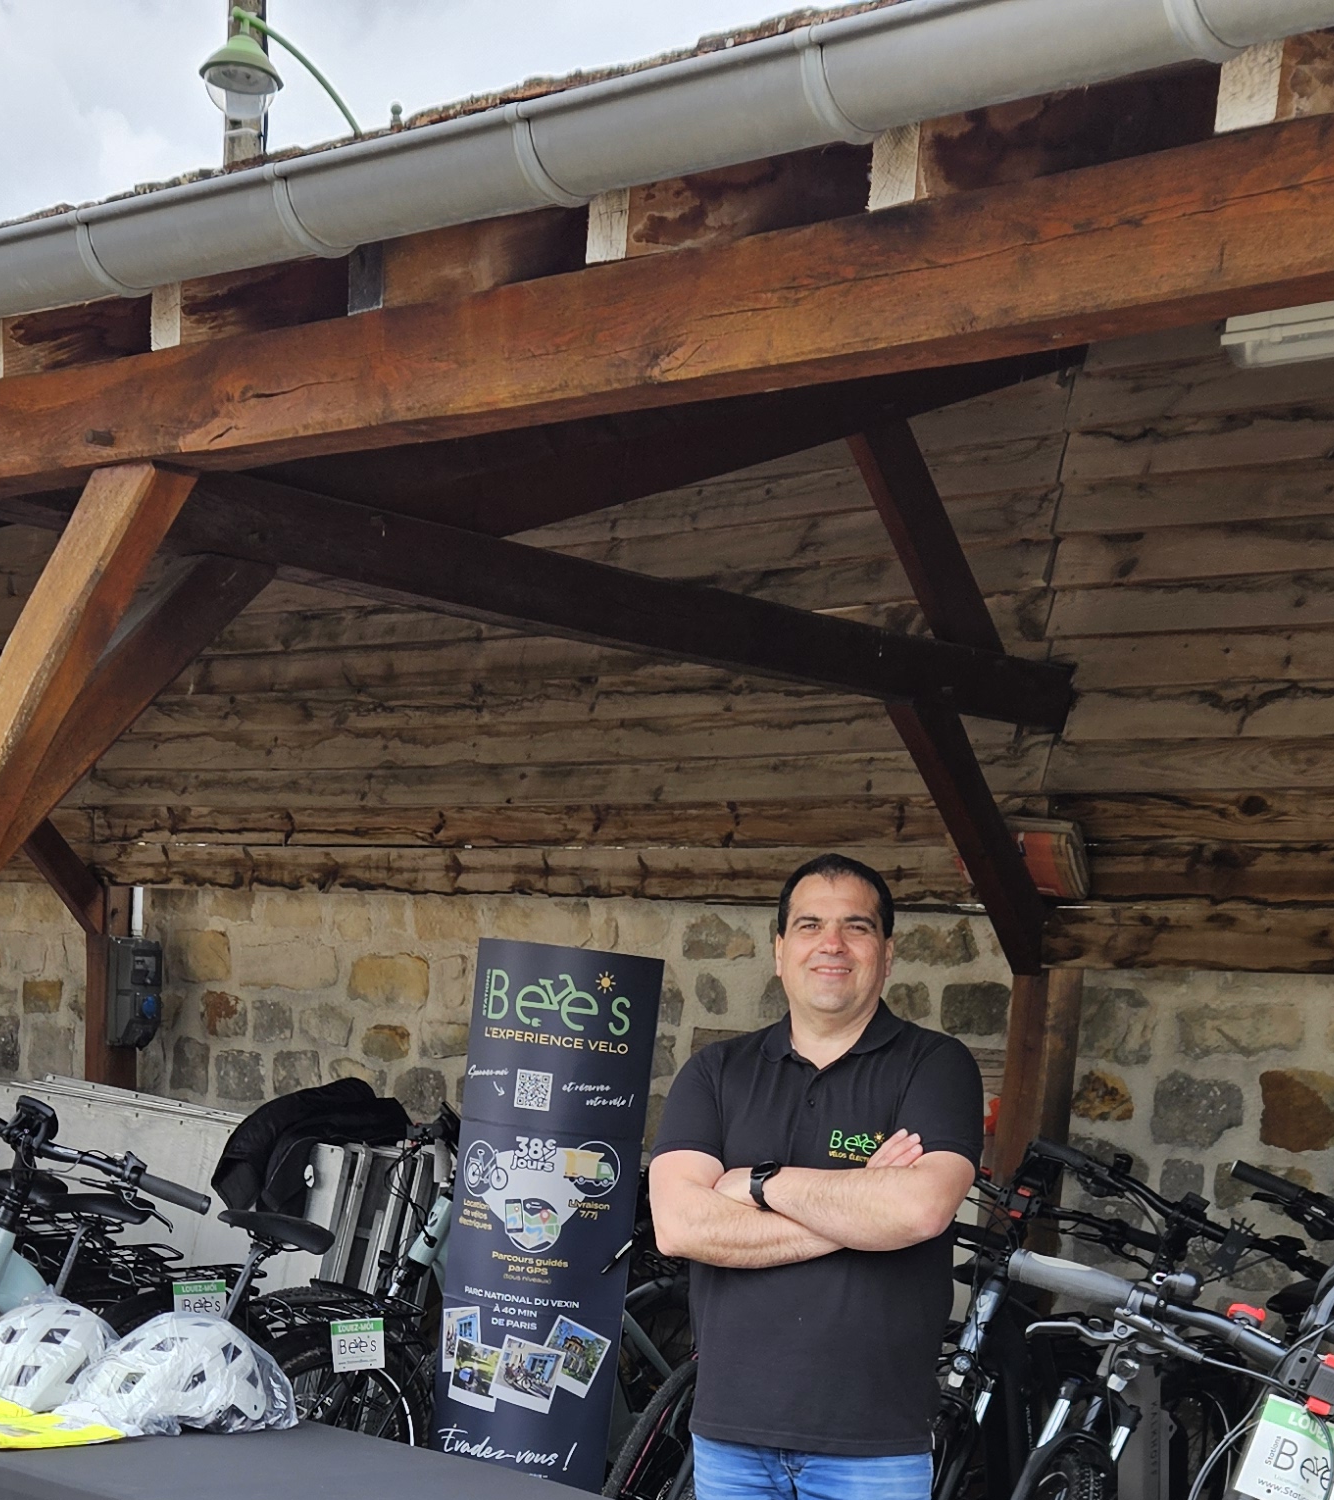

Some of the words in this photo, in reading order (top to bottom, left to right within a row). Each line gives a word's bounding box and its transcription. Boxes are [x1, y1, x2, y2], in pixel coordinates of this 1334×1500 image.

[484, 1026, 585, 1050] L'EXPERIENCE
[587, 1039, 630, 1056] VELO
[568, 1199, 610, 1211] Livraison
[491, 1250, 534, 1264] Parcours
[535, 1257, 569, 1268] guidés
[508, 1264, 525, 1273] par
[526, 1266, 549, 1276] GPS
[464, 1285, 484, 1297] PARC
[484, 1290, 533, 1305] NATIONAL
[534, 1298, 549, 1307] DU
[550, 1300, 580, 1309] VEXIN
[492, 1303, 501, 1314] À
[501, 1306, 516, 1315] 40
[517, 1309, 538, 1318] MIN
[491, 1317, 505, 1326] DE
[506, 1319, 538, 1331] PARIS
[437, 1423, 559, 1466] Évadez-vous
[1264, 1435, 1282, 1465] Stations
